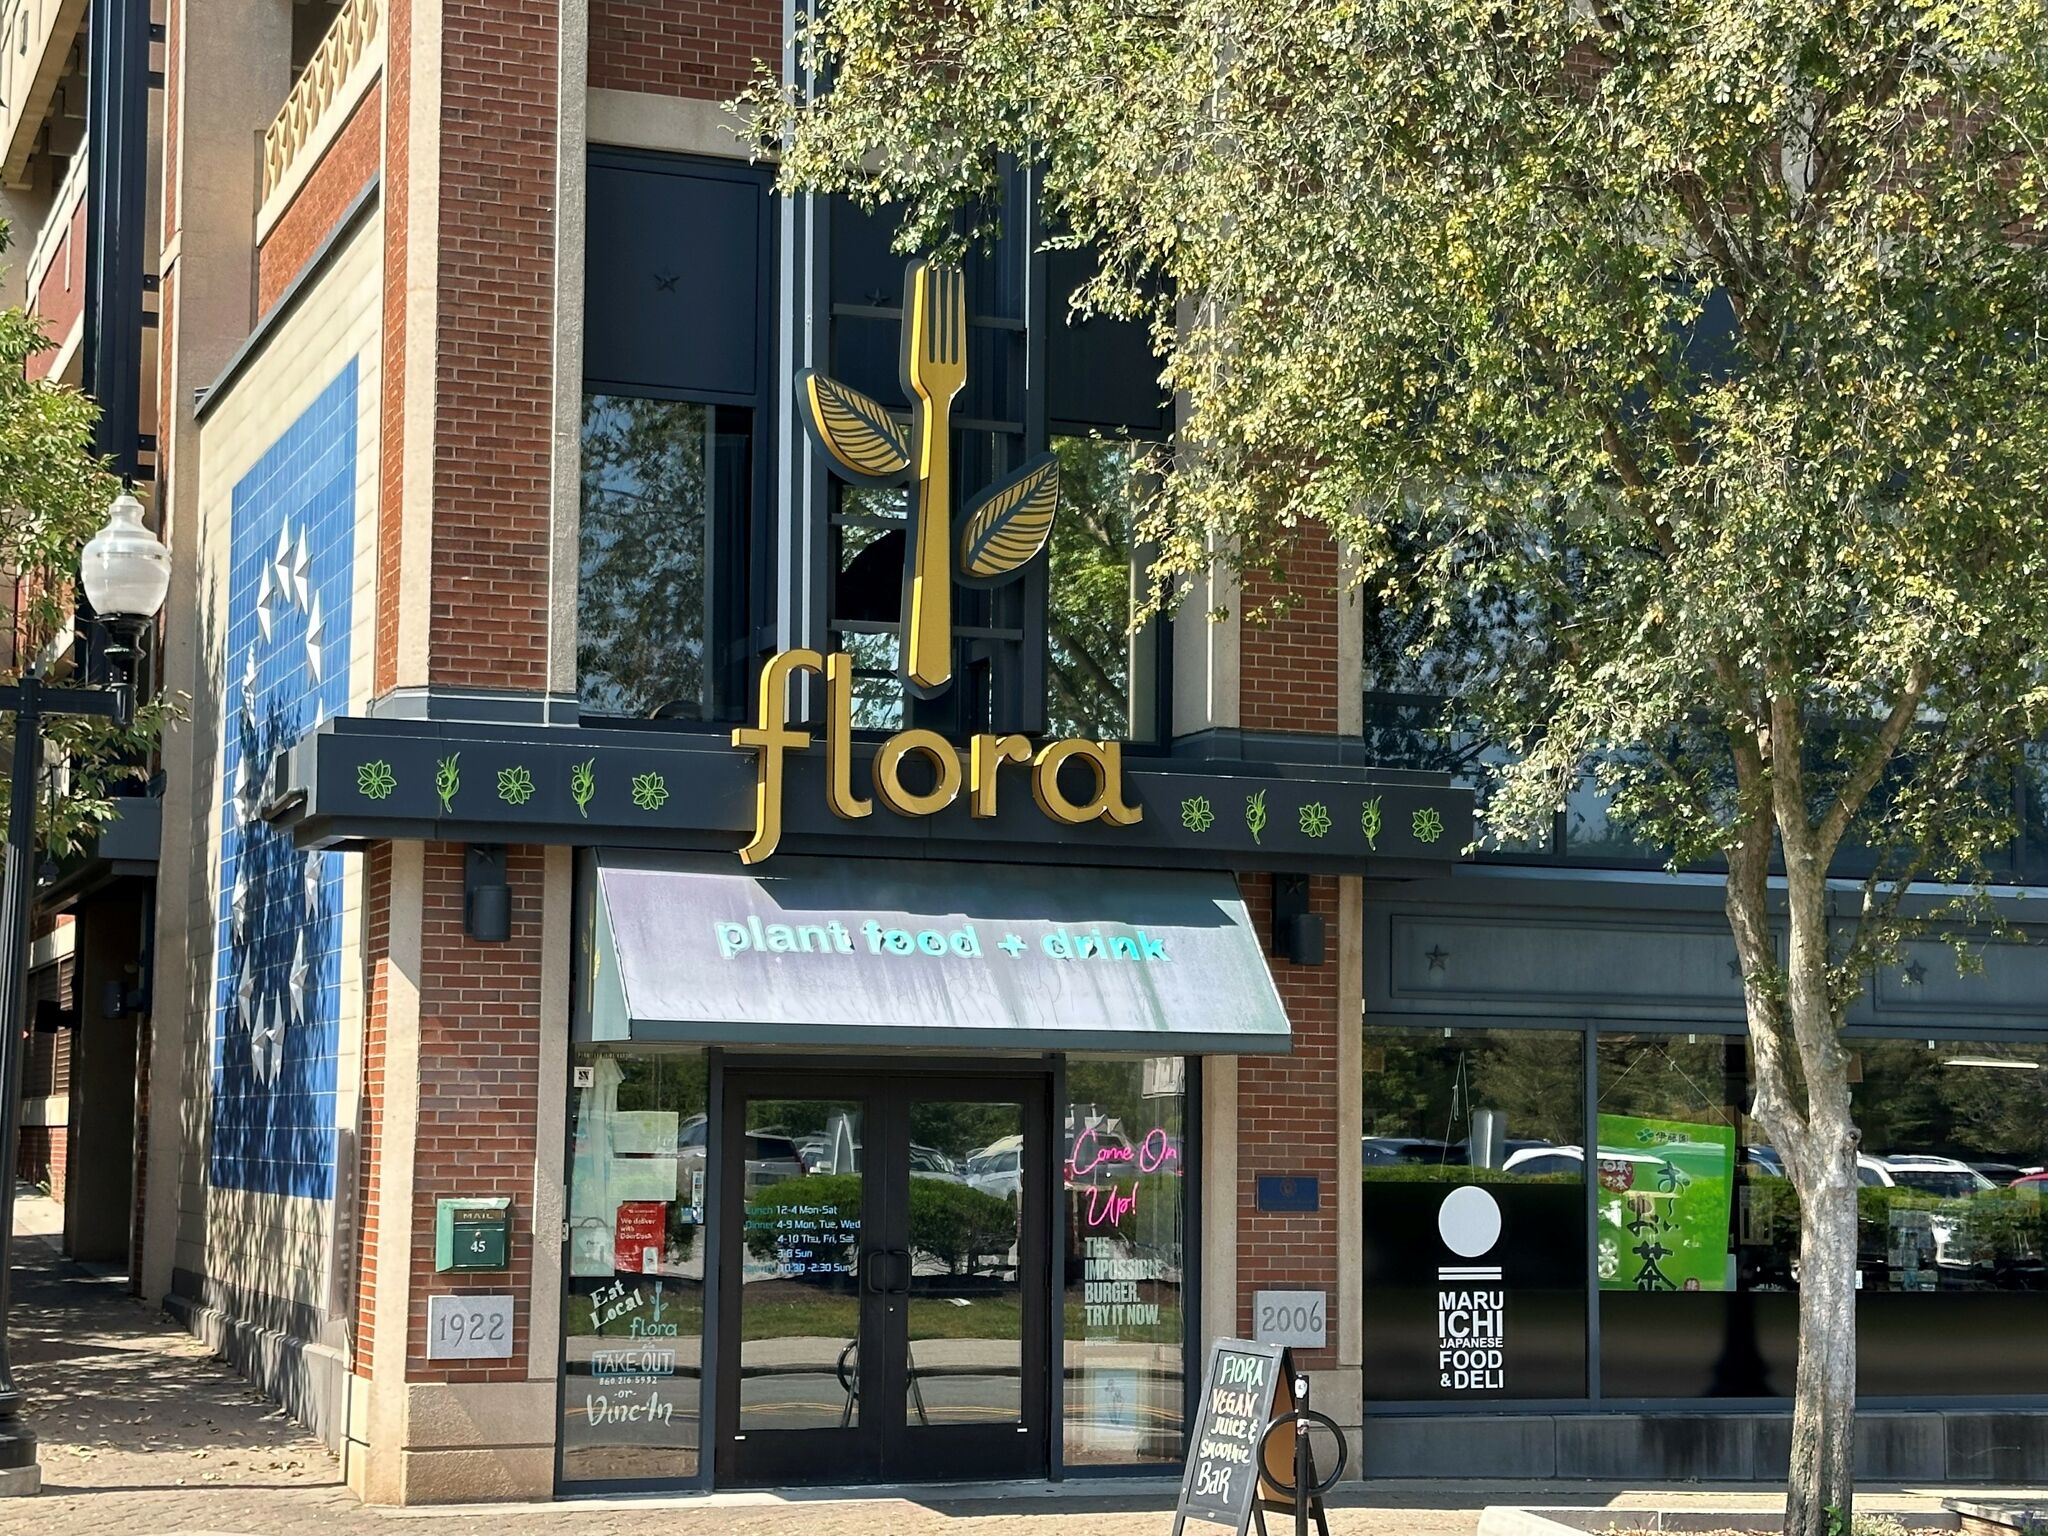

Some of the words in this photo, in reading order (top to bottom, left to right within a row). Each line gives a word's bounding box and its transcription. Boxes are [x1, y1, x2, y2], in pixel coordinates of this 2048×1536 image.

[731, 649, 1143, 865] flora
[715, 916, 853, 961] plant
[862, 919, 984, 960] food
[1042, 928, 1173, 962] drink
[1072, 1128, 1135, 1175] Come
[1140, 1128, 1178, 1173] On
[776, 1205, 797, 1214] 12-4
[1085, 1181, 1140, 1228] Up!
[819, 1220, 838, 1229] Tue,
[840, 1220, 861, 1229] Wed
[470, 1240, 486, 1252] 45
[794, 1249, 813, 1258] Sun
[1084, 1236, 1110, 1258] THE
[1084, 1259, 1163, 1280] IMPOSSIBLE
[589, 1279, 625, 1310] Eat
[1084, 1282, 1141, 1303] BURGER.
[1438, 1291, 1505, 1311] MARU
[588, 1287, 644, 1331] Local
[1084, 1305, 1110, 1326] TRY
[1111, 1305, 1125, 1325] IT
[1126, 1304, 1161, 1326] NOW.
[1262, 1301, 1322, 1333] 2006
[440, 1313, 505, 1348] 1922
[629, 1316, 678, 1341] flora
[1438, 1311, 1505, 1338] ICHI
[1439, 1337, 1504, 1349] JAPANESE
[1439, 1350, 1503, 1370] FOOD
[1454, 1370, 1504, 1389] DELI
[1212, 1388, 1259, 1418] VEGAN
